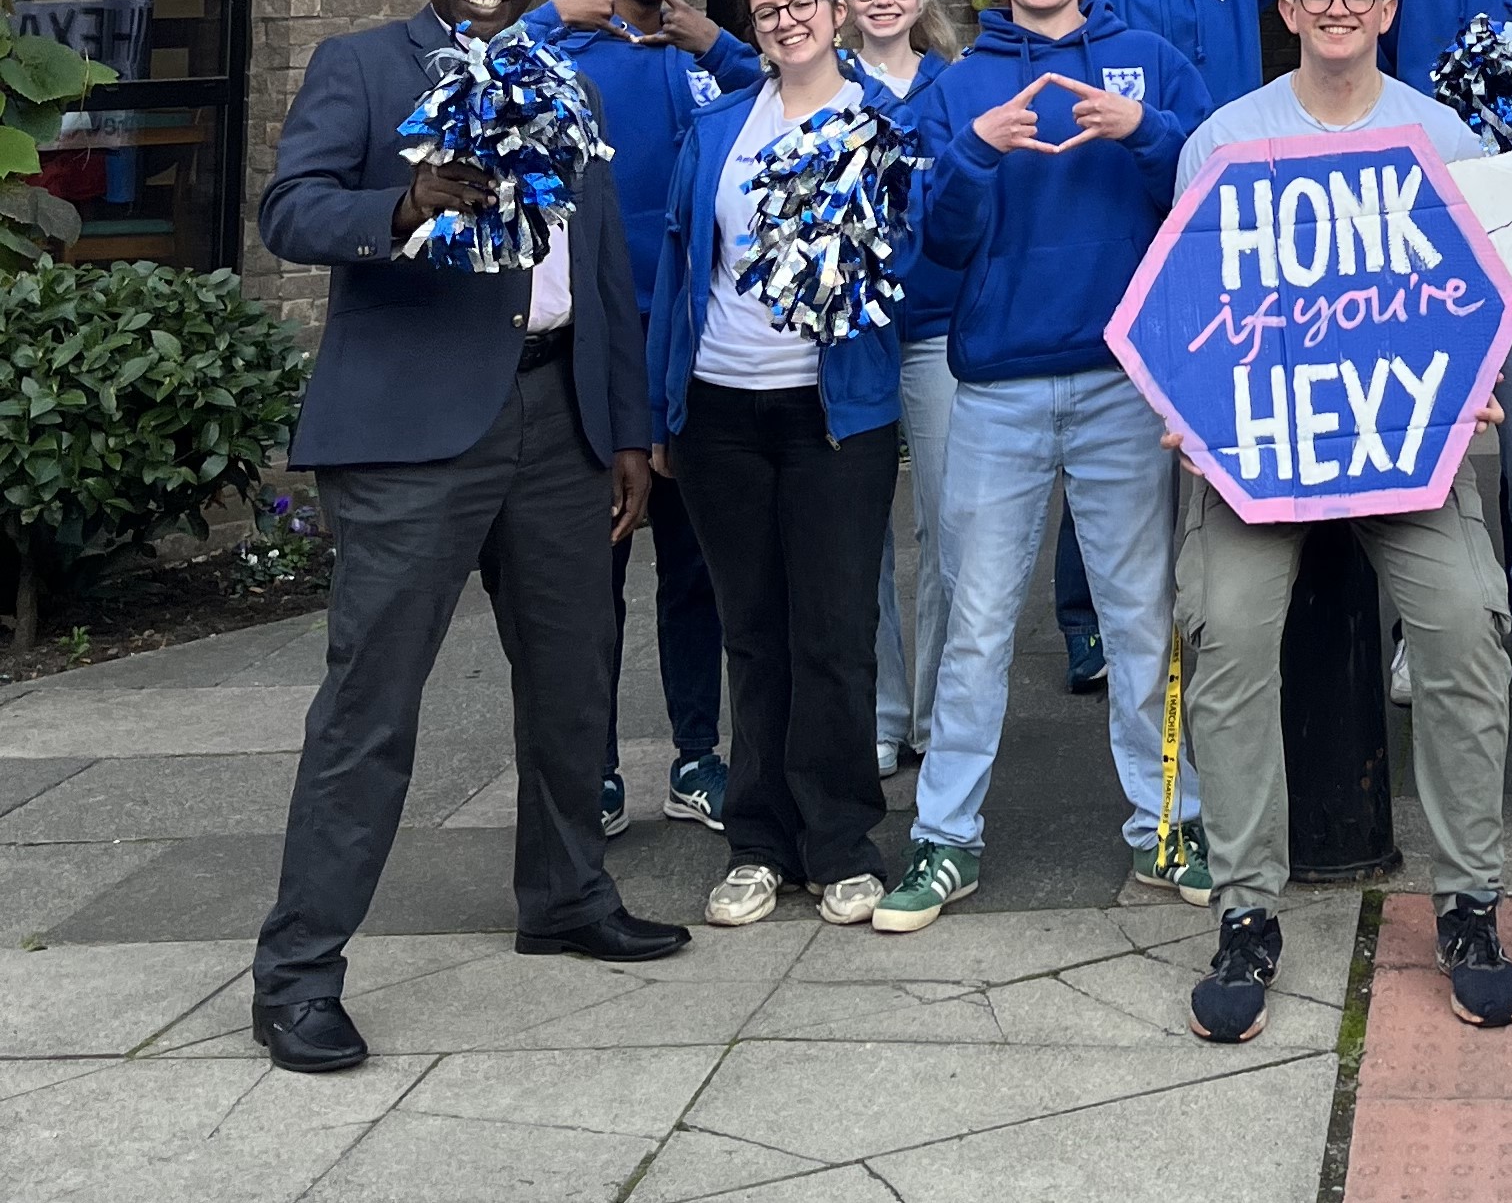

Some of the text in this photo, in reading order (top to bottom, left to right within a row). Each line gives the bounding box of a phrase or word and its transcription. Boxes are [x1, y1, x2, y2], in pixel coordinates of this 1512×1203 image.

[1219, 164, 1443, 291] HONK
[1187, 272, 1485, 365] if you're
[1221, 350, 1449, 485] HEXY
[1166, 693, 1179, 744] THATCHERS
